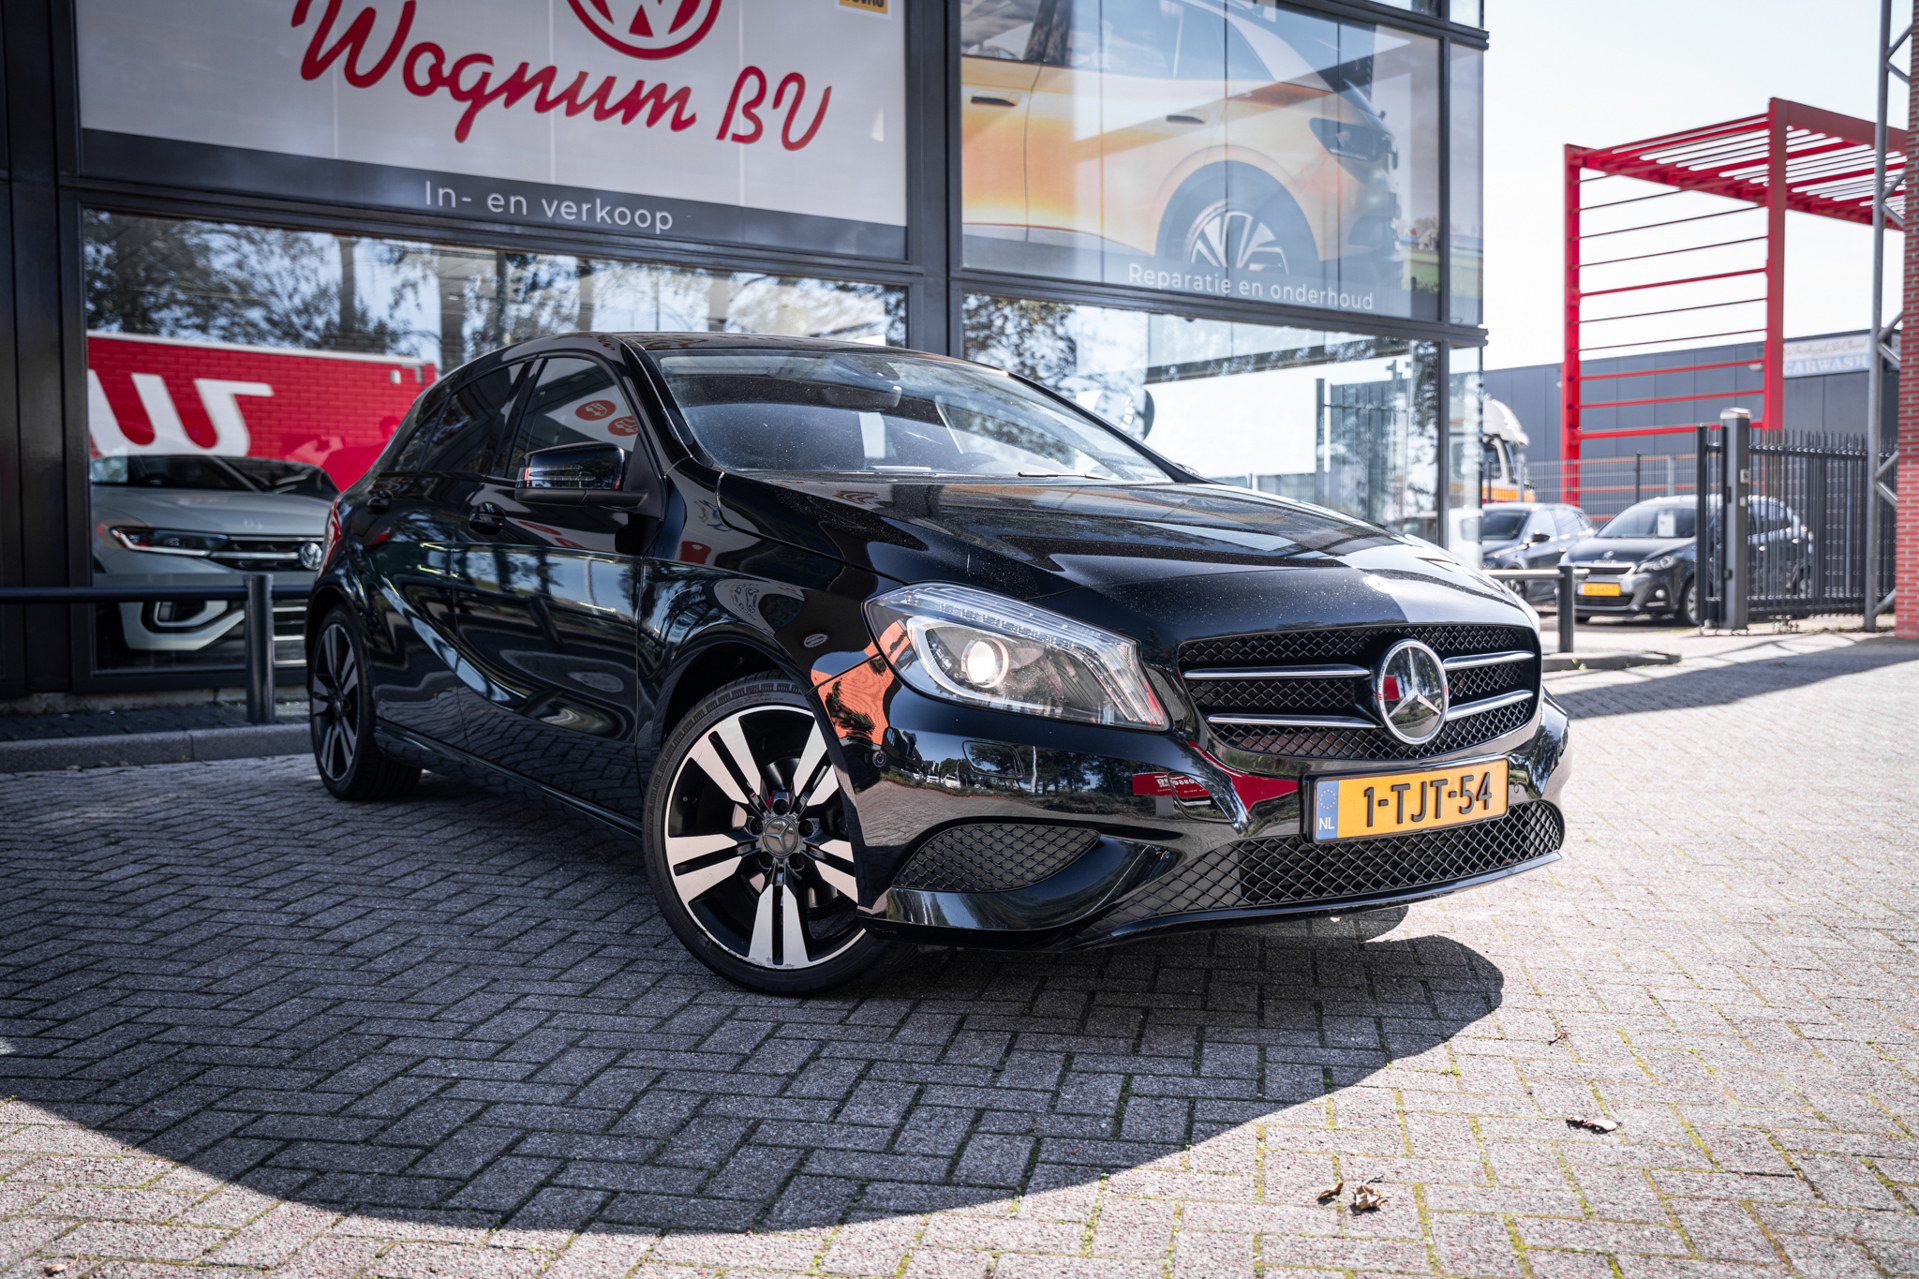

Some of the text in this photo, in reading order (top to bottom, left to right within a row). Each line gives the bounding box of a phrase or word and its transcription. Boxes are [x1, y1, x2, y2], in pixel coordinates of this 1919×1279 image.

[291, 0, 697, 143] Wognum
[716, 66, 832, 151] BV
[425, 180, 673, 235] In- en verkoop
[1129, 263, 1374, 311] Reparatie en onderhoud
[1784, 354, 1868, 374] CARWASH
[1319, 817, 1335, 830] NL
[1364, 772, 1492, 827] 1-TJT-54
